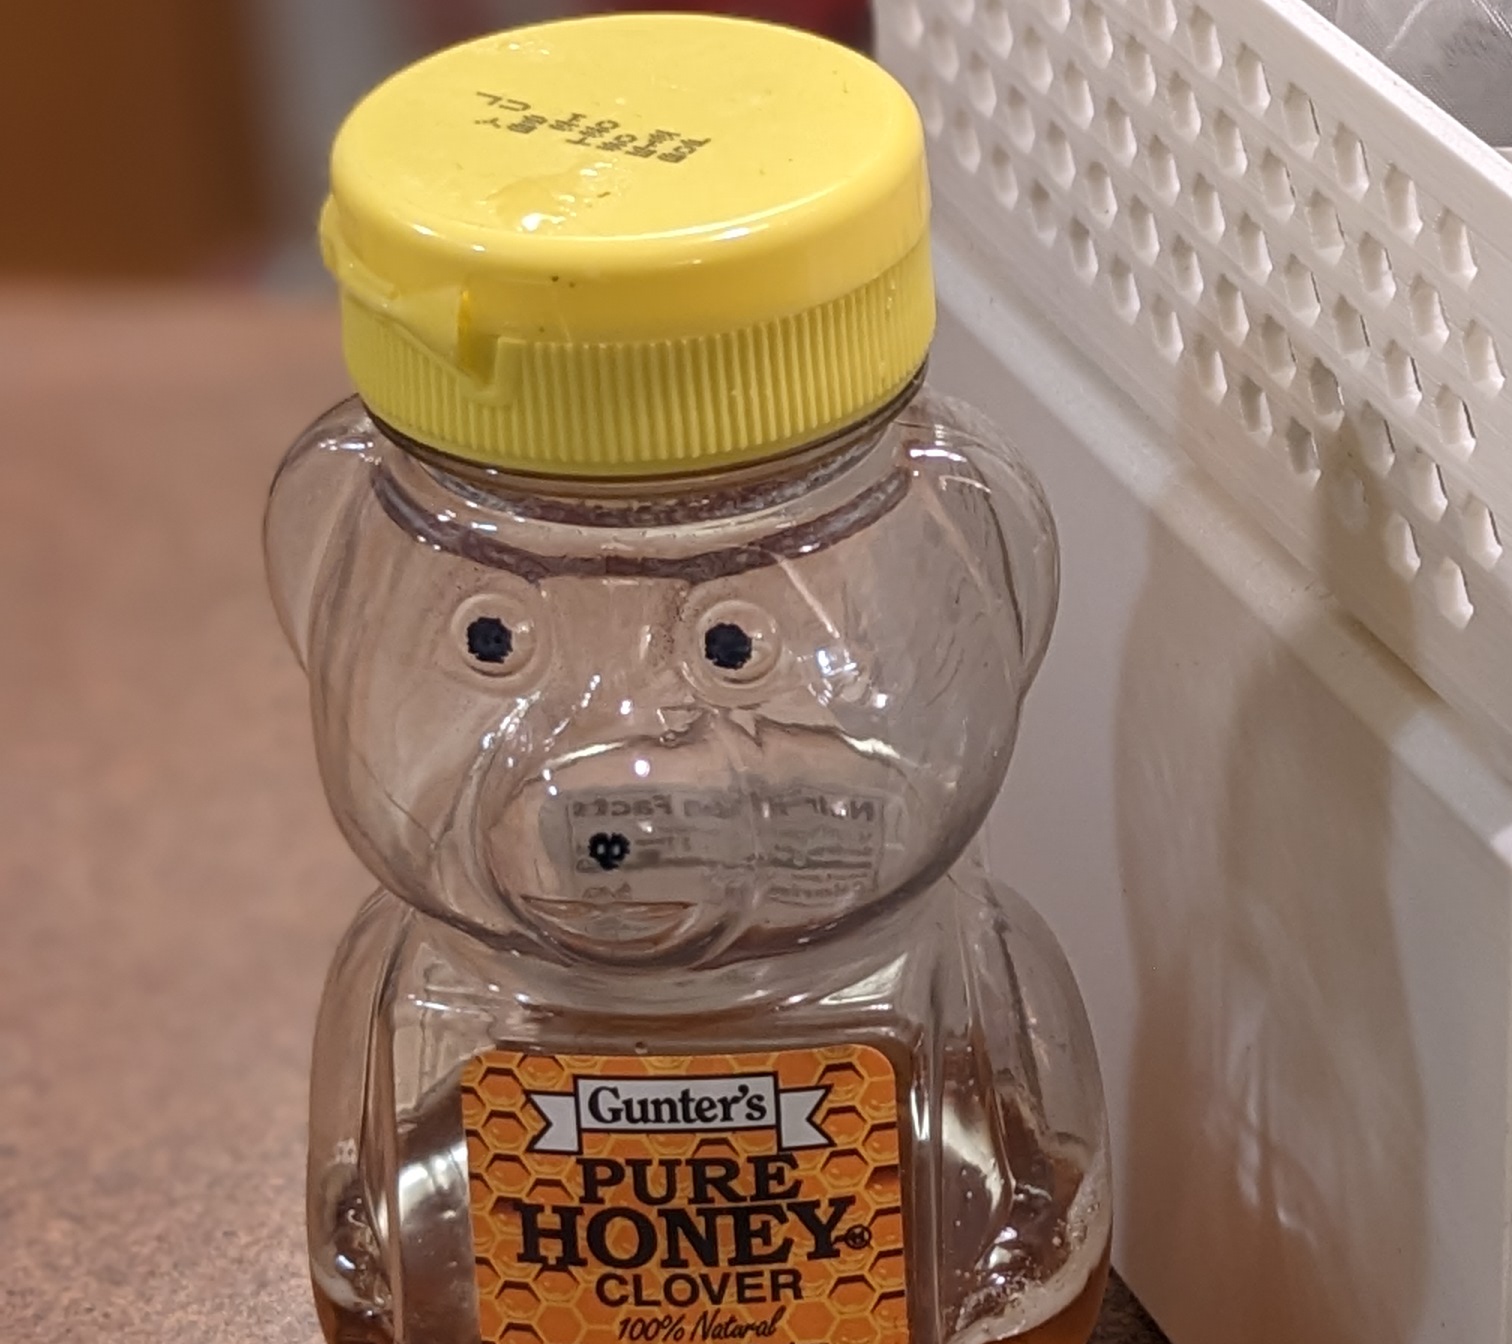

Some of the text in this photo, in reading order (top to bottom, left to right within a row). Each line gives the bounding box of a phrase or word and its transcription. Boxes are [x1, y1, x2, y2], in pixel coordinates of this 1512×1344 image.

[587, 1084, 767, 1124] Gunter's
[576, 1152, 803, 1206] PURE
[595, 1268, 804, 1307] CLOVER
[618, 1305, 786, 1342] 100% Natural
